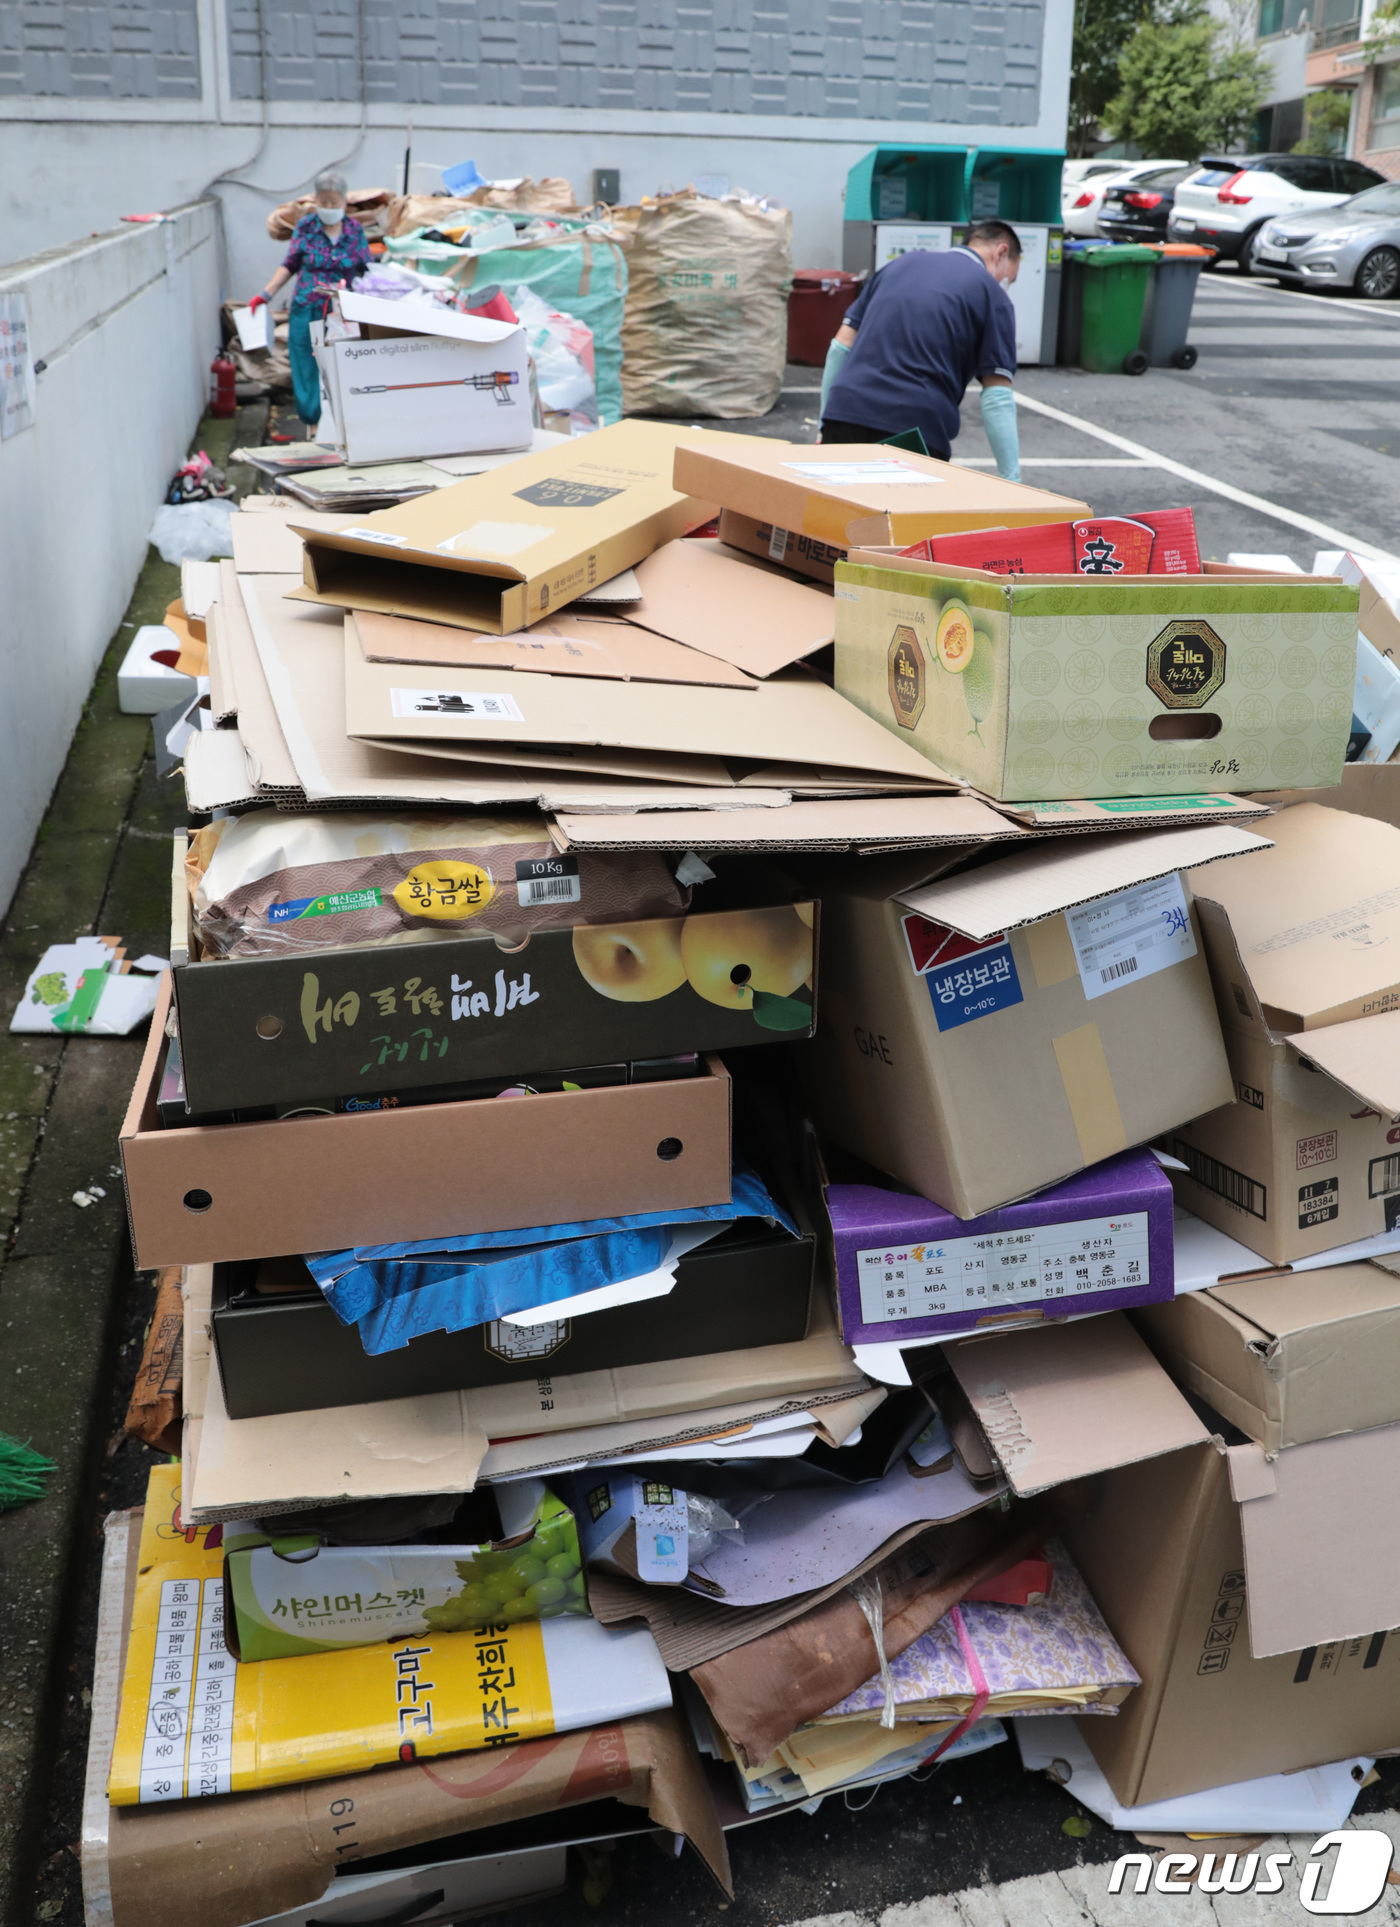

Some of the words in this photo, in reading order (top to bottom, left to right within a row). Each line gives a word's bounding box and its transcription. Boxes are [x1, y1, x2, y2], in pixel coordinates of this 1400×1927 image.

[345, 347, 376, 359] dyson
[379, 343, 409, 356] digital
[410, 342, 429, 353] slim
[982, 560, 1007, 572] 라면은
[1008, 557, 1022, 568] 농심
[1173, 641, 1204, 664] 메론
[899, 649, 915, 678] 메론
[1209, 759, 1241, 775] 청양
[530, 862, 546, 876] 10
[548, 861, 564, 878] Kg
[328, 889, 377, 907] 예산군농협
[407, 875, 485, 906] 황금쌀
[274, 907, 290, 920] NH
[934, 956, 1010, 1004] 냉장보관
[449, 970, 540, 1020] 계백
[370, 1028, 448, 1072] 신선
[854, 1026, 894, 1066] GAE
[1244, 1088, 1250, 1099] 4
[1254, 1091, 1263, 1106] M
[1299, 1134, 1334, 1154] 냉장보관
[1325, 1180, 1331, 1190] 7
[1302, 1195, 1334, 1212] 183384
[1307, 1208, 1330, 1224] 6개입
[996, 1238, 1004, 1247] 후
[865, 1256, 882, 1264] 학산
[885, 1253, 908, 1265] 송이
[1001, 1254, 1028, 1266] 영동군
[1069, 1255, 1087, 1264] 충북
[1090, 1250, 1116, 1261] 영동군
[925, 1266, 944, 1275] 포도
[924, 1283, 948, 1293] MBA
[1076, 1274, 1142, 1291] 010-2058-1683
[928, 1303, 946, 1311] 3kg
[158, 1314, 172, 1340] 35
[146, 1342, 169, 1387] 110
[537, 1377, 553, 1396] 상품
[540, 1400, 554, 1411] 본
[173, 1583, 189, 1603] 왕파
[271, 1588, 426, 1620] 샤인머스켓
[171, 1610, 187, 1627] B품
[297, 1609, 417, 1629] Shinemuscat
[169, 1634, 185, 1654] 꼬불
[1320, 1651, 1335, 1669] 코멧
[165, 1660, 182, 1680] 공하
[207, 1680, 223, 1701] 긴하
[393, 1646, 435, 1737] 고구마
[204, 1704, 221, 1732] 긴긴중
[156, 1745, 173, 1757] 중
[202, 1734, 220, 1759] 긴중
[154, 1780, 171, 1794] 상
